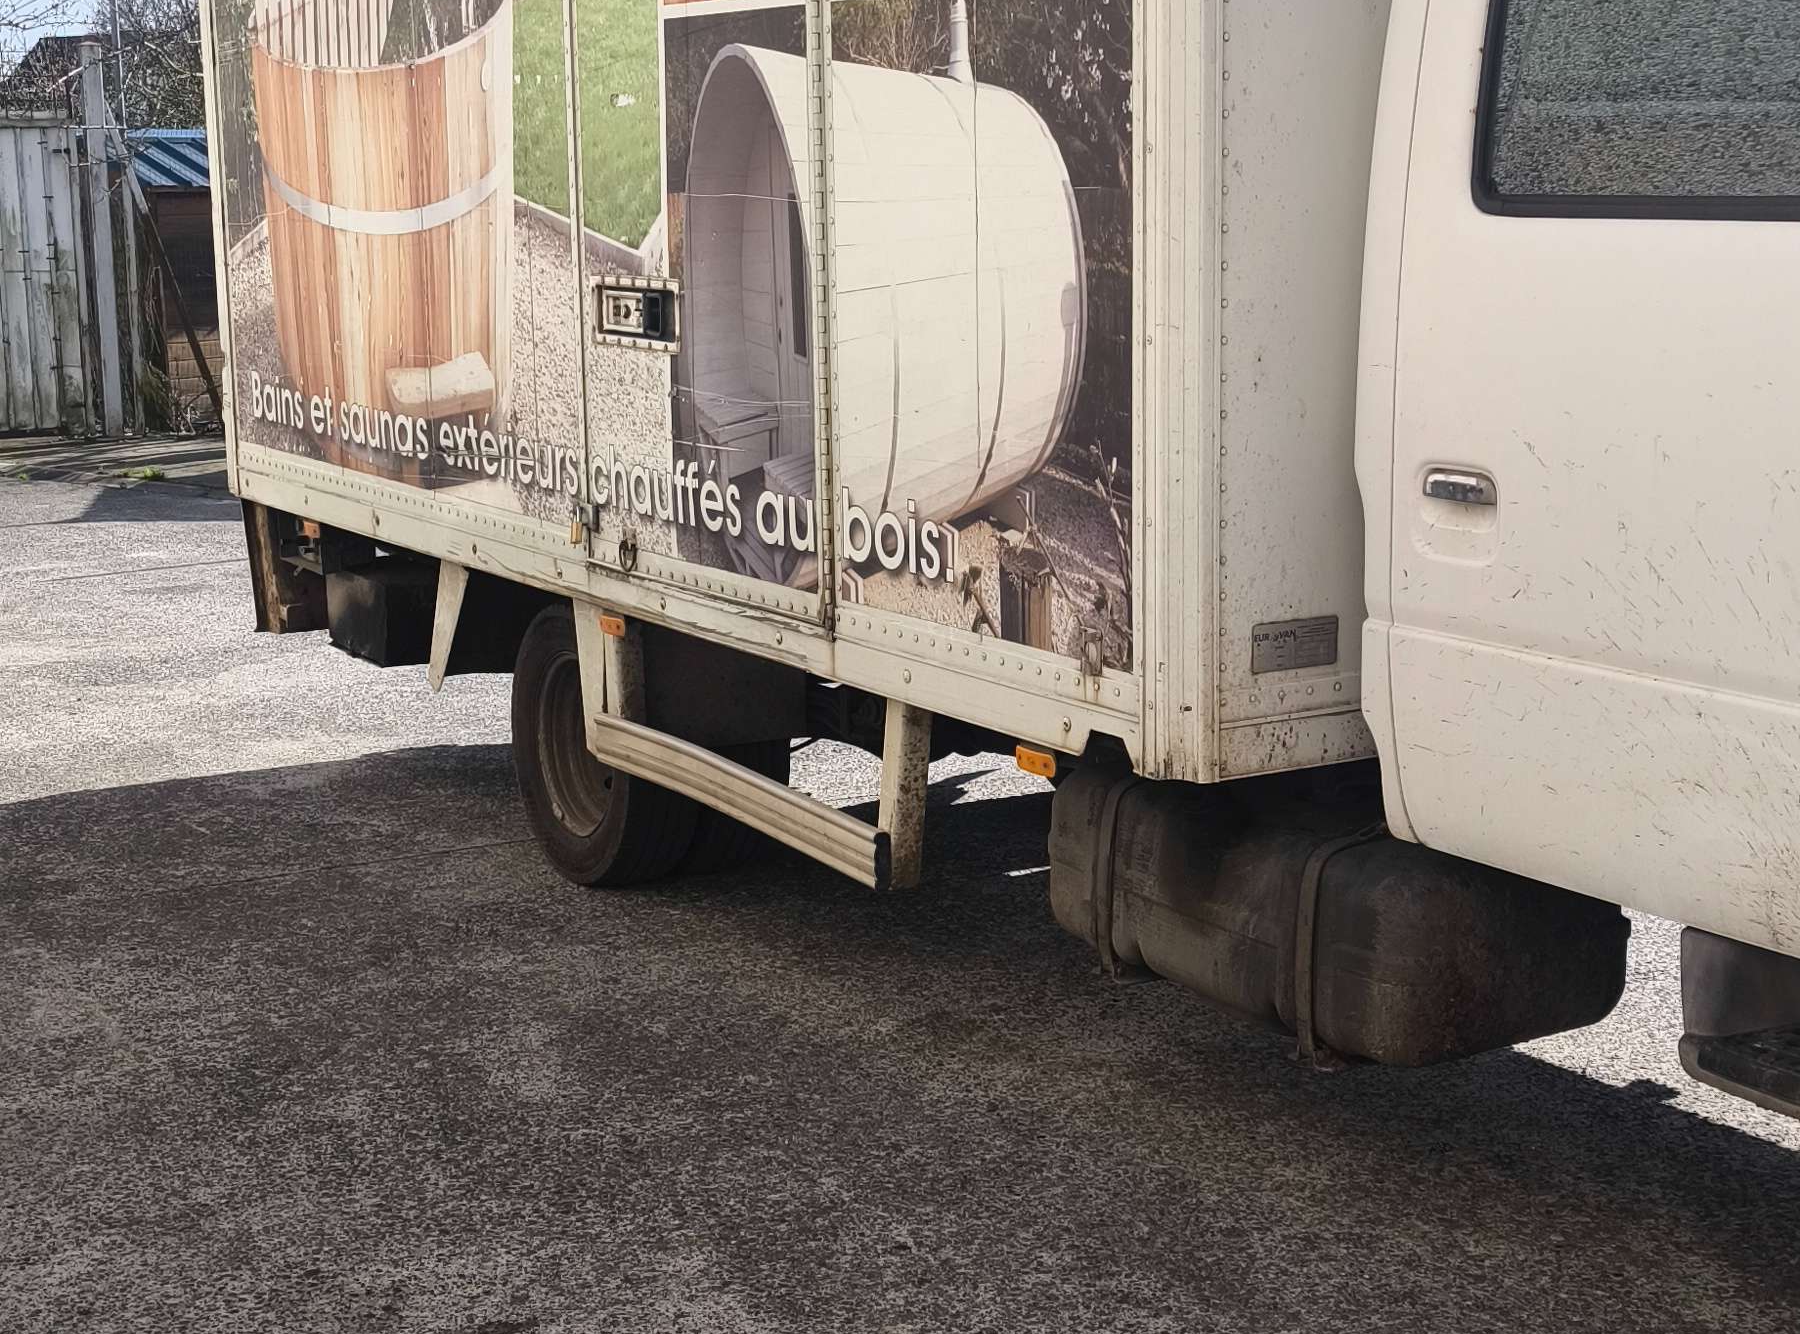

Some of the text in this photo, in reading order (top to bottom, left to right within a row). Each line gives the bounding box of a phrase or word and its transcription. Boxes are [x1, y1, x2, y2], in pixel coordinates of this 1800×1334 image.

[251, 370, 304, 429] Bains
[310, 386, 332, 436] et
[340, 400, 429, 460] saunas
[439, 412, 579, 496] extérieurs
[591, 443, 742, 537] chauffés
[756, 490, 816, 553] au
